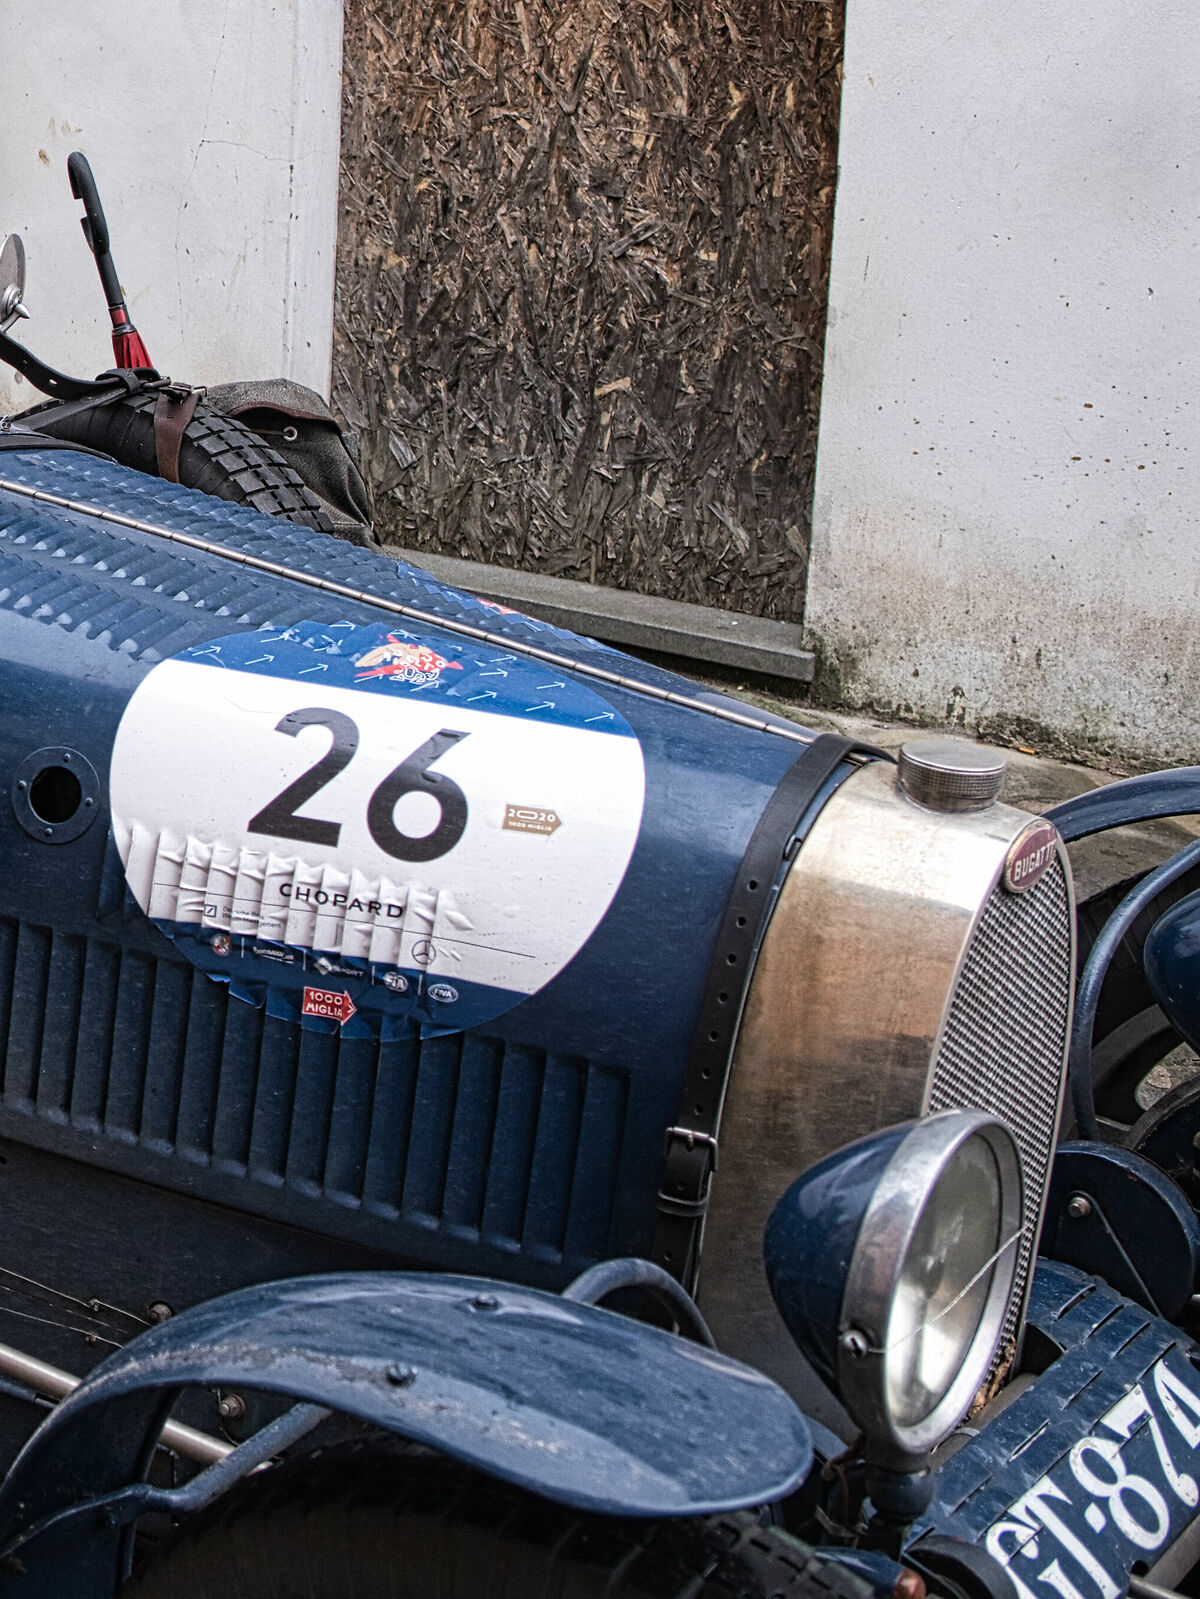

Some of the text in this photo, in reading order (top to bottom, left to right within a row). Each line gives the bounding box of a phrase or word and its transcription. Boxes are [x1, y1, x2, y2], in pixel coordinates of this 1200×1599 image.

[247, 707, 472, 863] 26
[279, 883, 404, 918] CHOPARD
[305, 1003, 343, 1017] MIGLIA
[309, 991, 343, 1006] 1000
